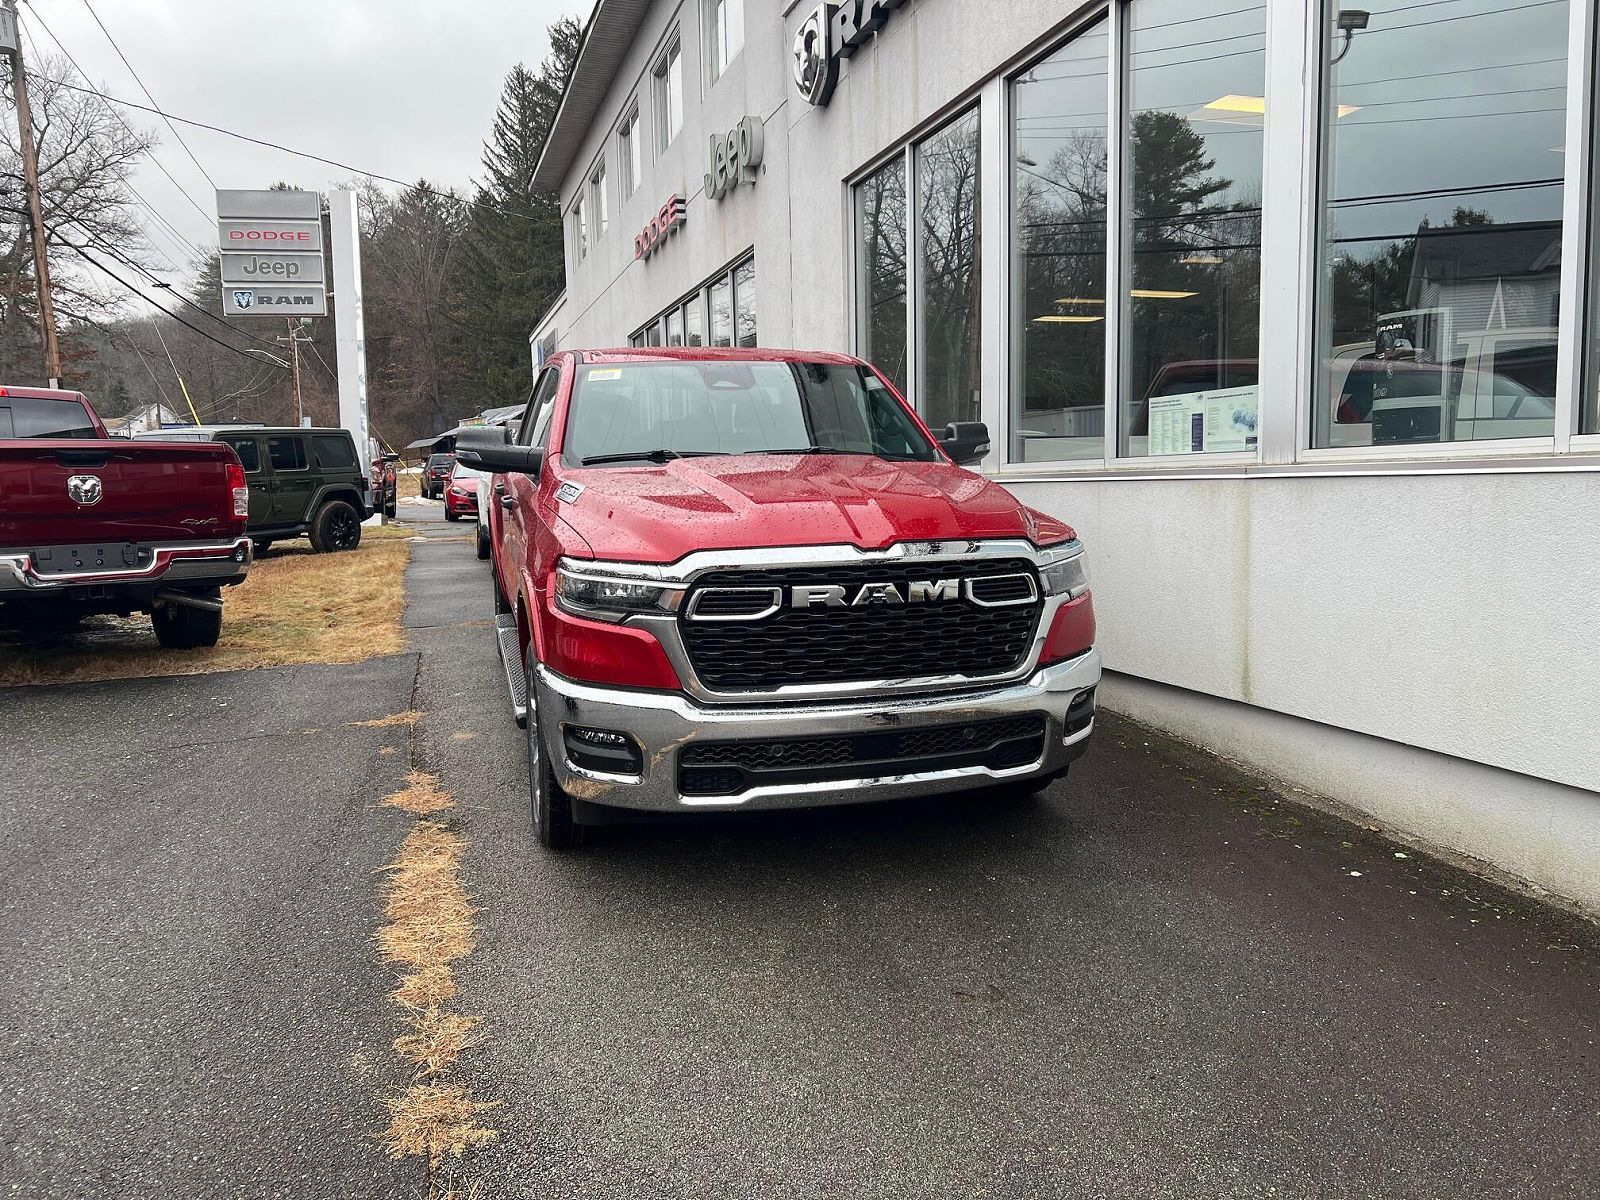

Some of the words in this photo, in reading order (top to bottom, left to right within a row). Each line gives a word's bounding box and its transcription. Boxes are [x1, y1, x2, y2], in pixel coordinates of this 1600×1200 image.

[704, 115, 764, 200] Jeep
[229, 231, 310, 240] DODGE
[635, 193, 687, 260] DODGE
[243, 256, 300, 279] Jeep
[257, 296, 314, 305] RAM
[791, 578, 959, 609] RAM
